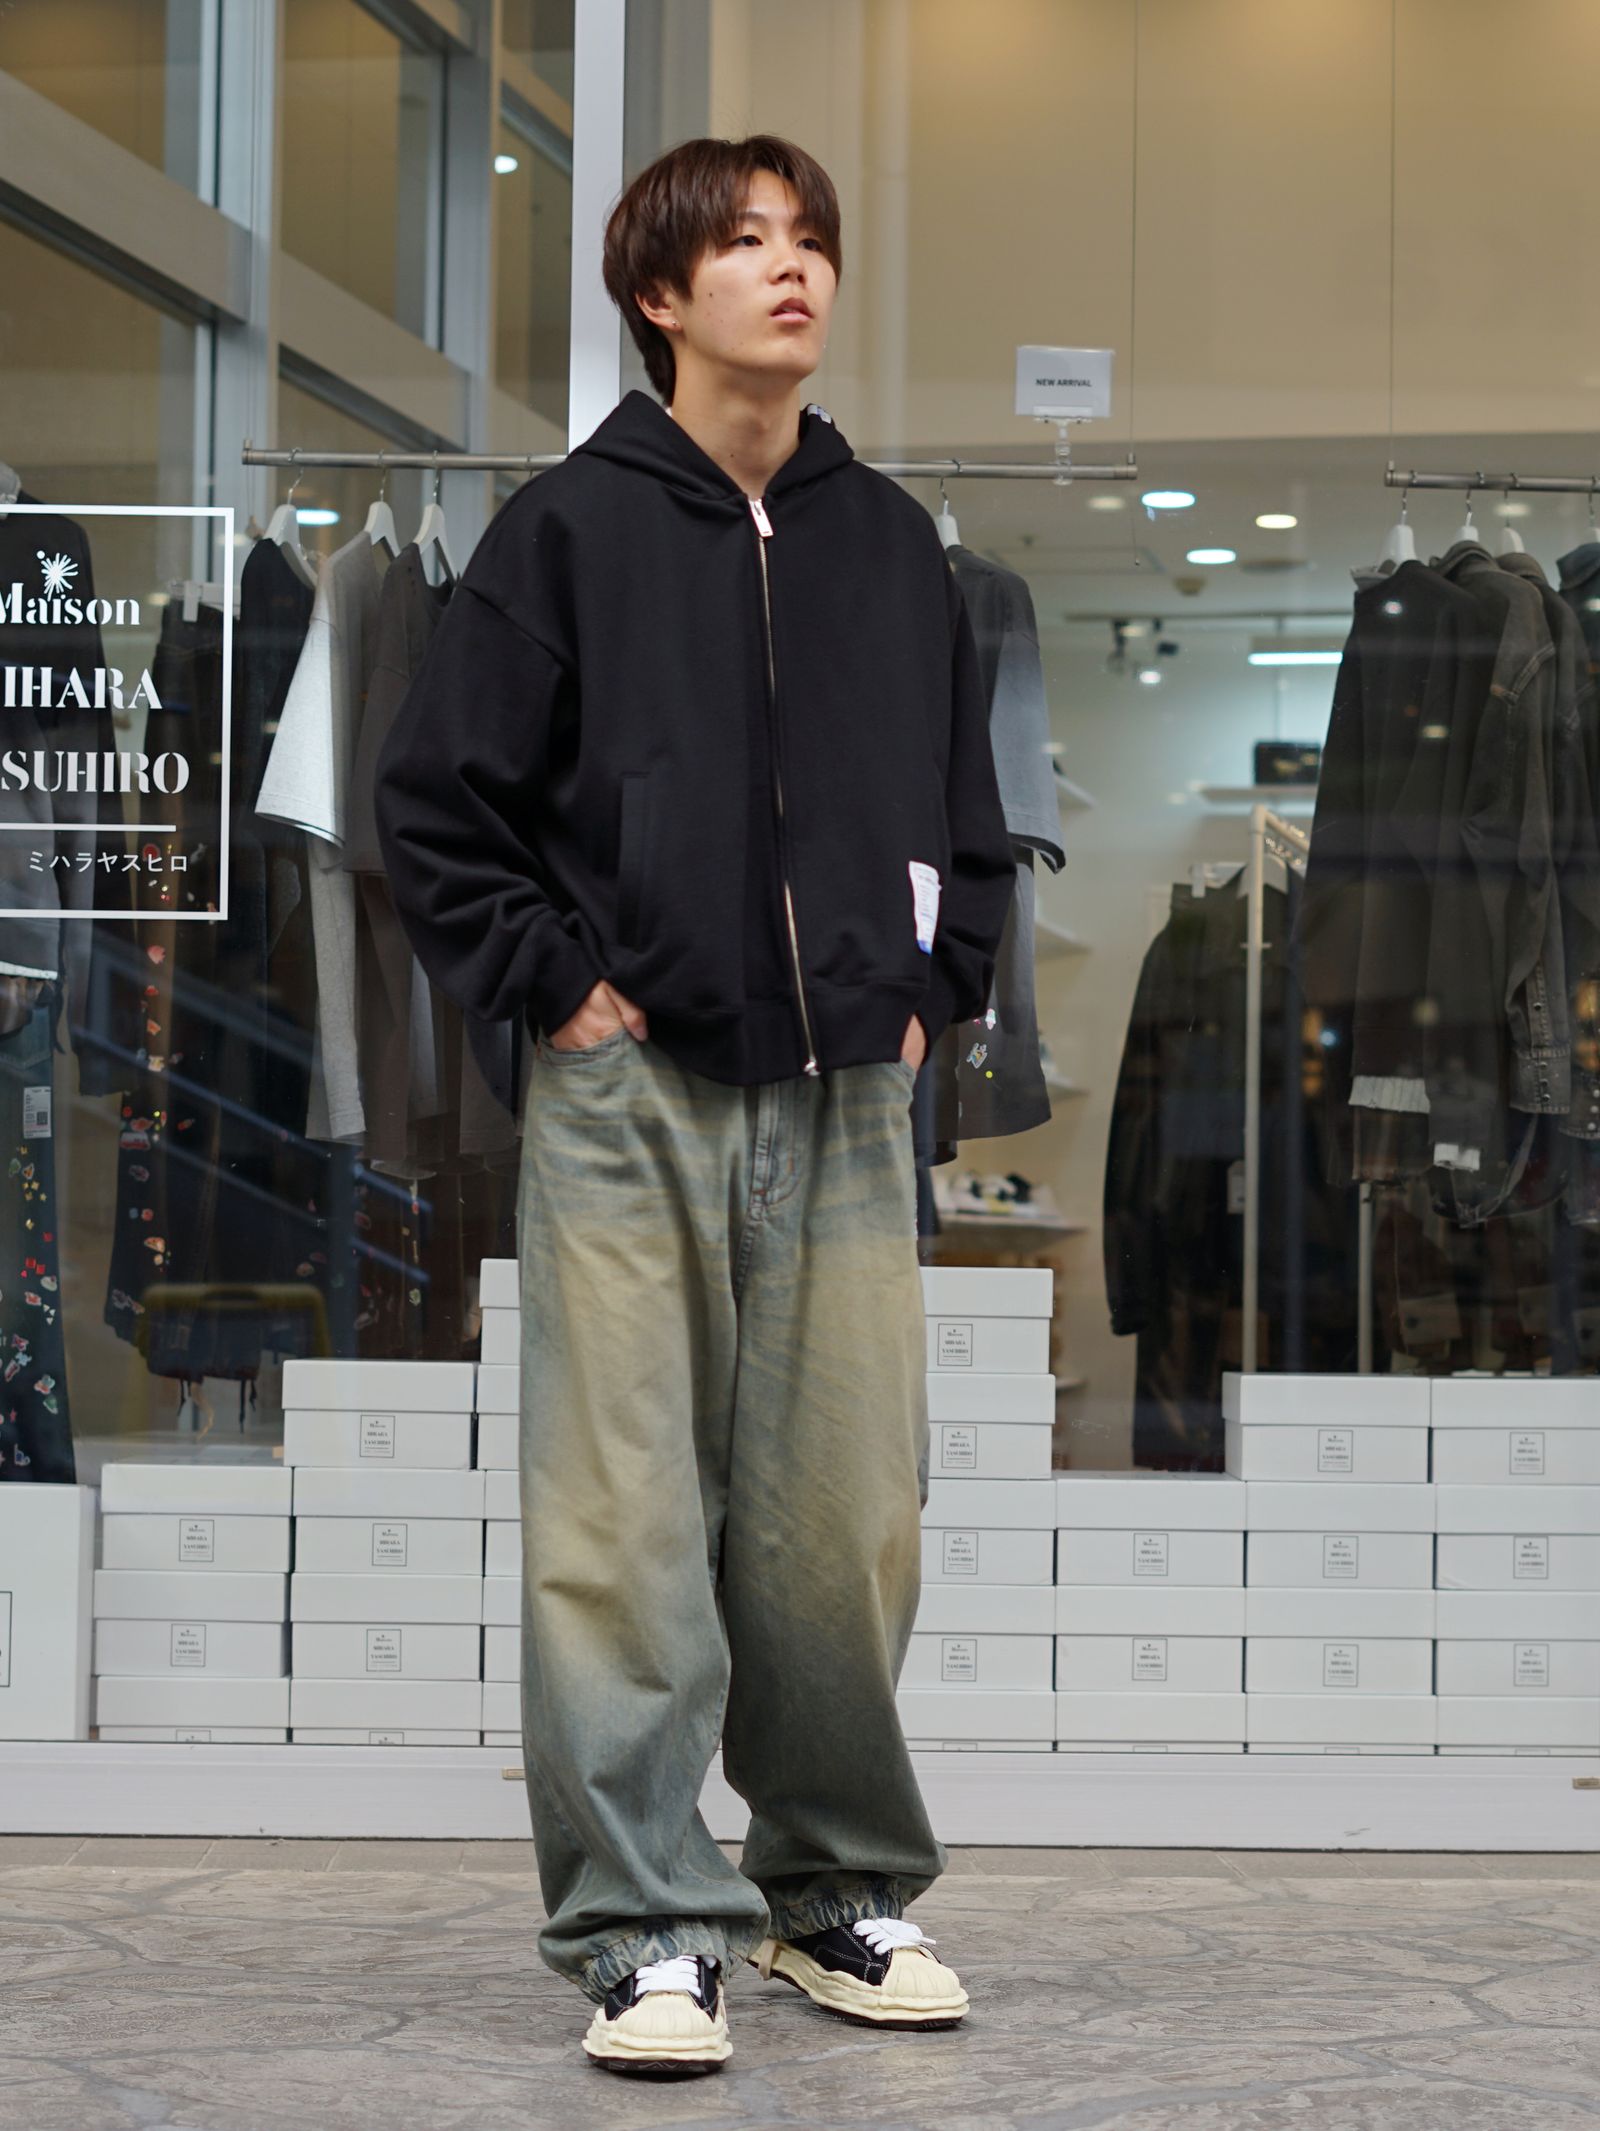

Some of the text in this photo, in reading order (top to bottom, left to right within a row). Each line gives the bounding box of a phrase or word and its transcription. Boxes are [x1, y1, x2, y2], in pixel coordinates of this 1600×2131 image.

[1036, 378, 1093, 388] NEW ARRIVAL
[29, 850, 188, 873] ミハラヤスヒロ
